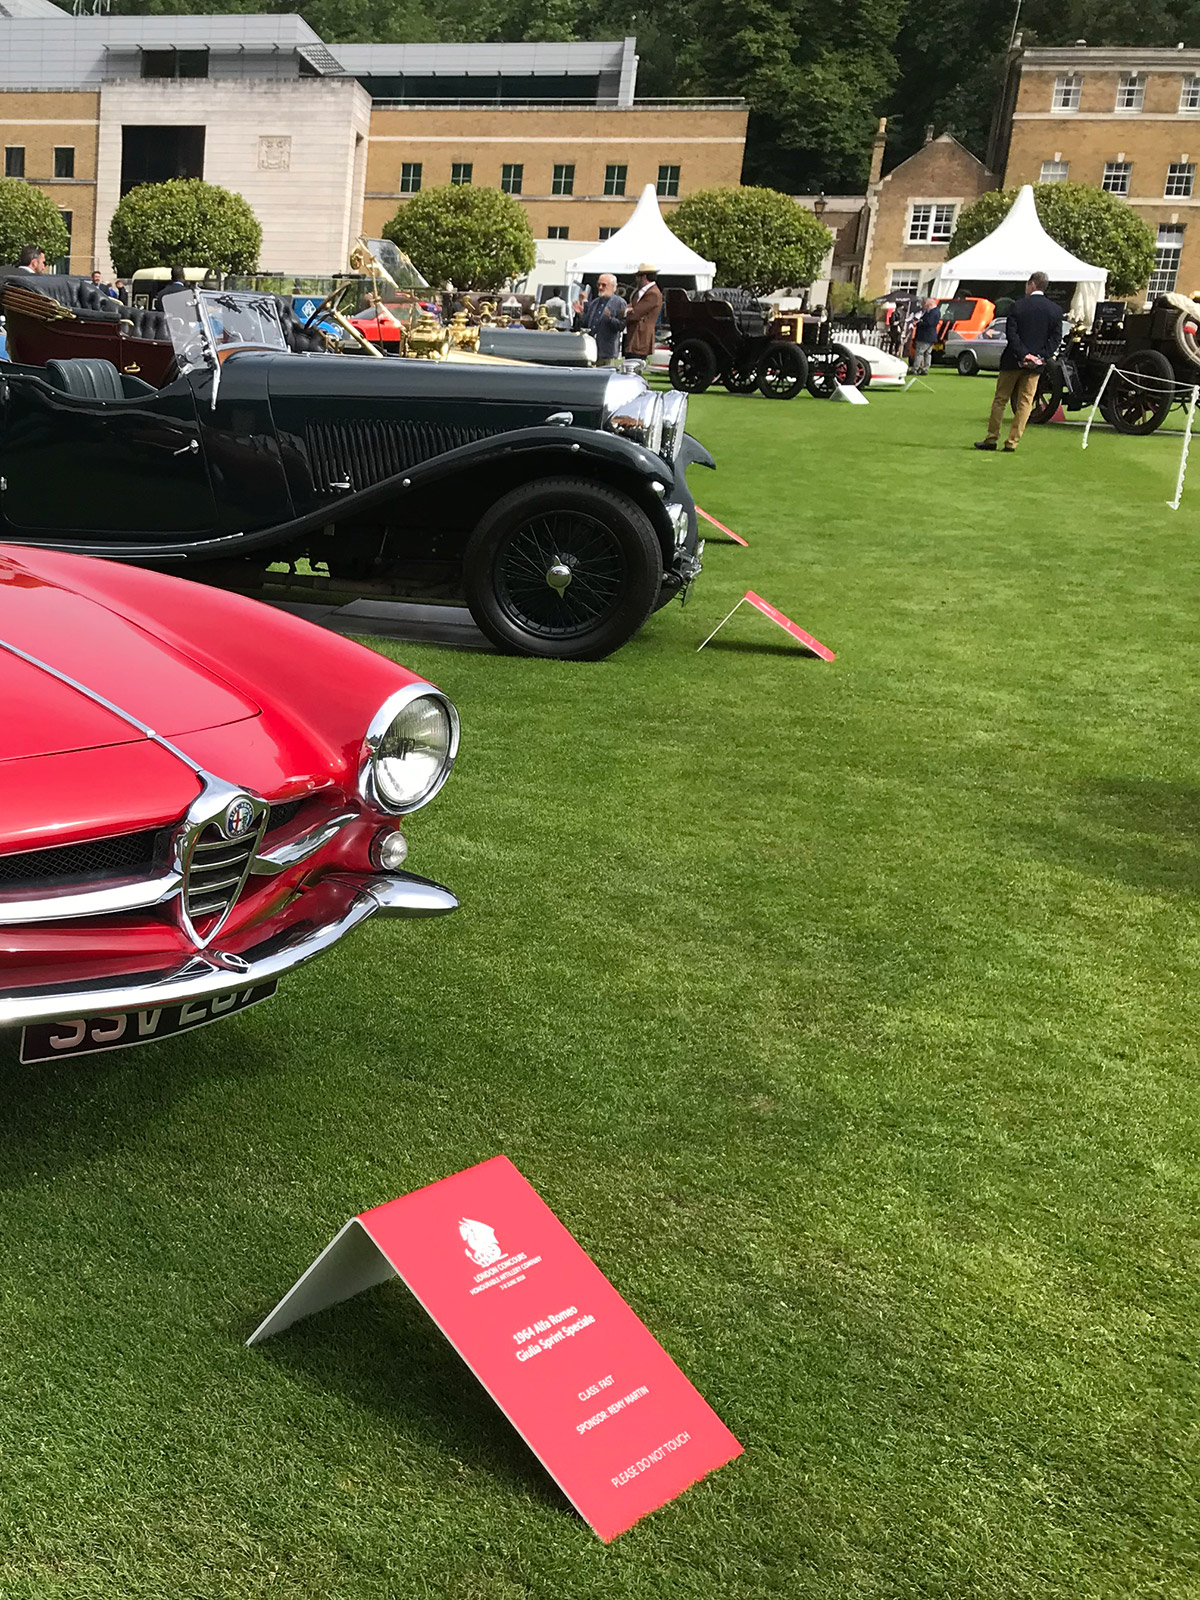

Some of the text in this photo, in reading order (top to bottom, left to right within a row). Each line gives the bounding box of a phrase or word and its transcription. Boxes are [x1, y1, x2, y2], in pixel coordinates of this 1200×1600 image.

[470, 1276, 501, 1295] HONOURABLE
[473, 1252, 527, 1283] LONDON CONCOURS
[513, 1306, 578, 1345] 1964 Alfa Romeo
[516, 1314, 596, 1362] Giulia Sprint Speciale
[578, 1374, 615, 1402] CLASS: FAST
[576, 1385, 650, 1435] SPONSOR: REMY MARTIN
[611, 1430, 692, 1488] PLEASE DO NOT TOUCH
